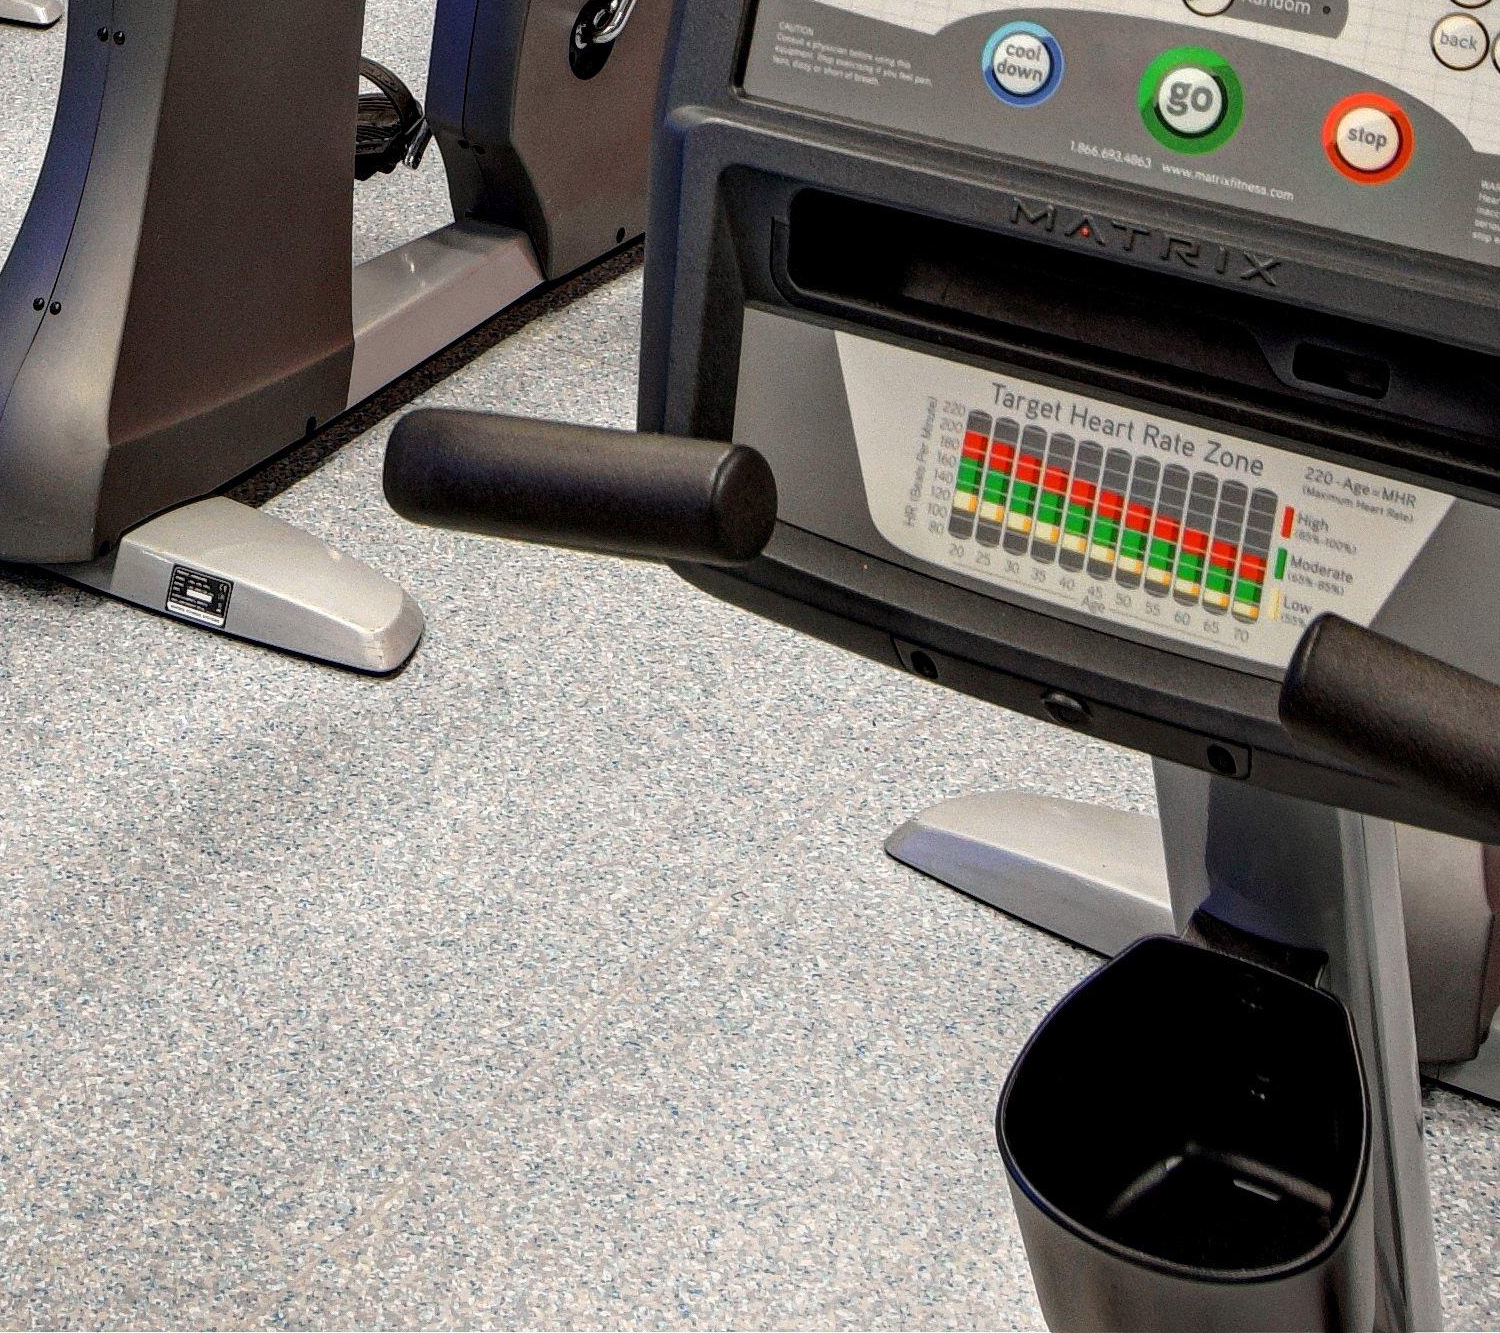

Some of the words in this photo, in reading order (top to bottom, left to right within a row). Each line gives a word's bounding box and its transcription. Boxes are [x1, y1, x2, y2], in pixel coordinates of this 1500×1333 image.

[1005, 43, 1041, 61] cool
[1440, 30, 1478, 52] back
[997, 59, 1043, 83] down
[1166, 81, 1213, 117] go
[1347, 125, 1388, 151] stop
[1161, 162, 1295, 202] www.matrixfitness.com
[1009, 195, 1282, 288] MATRIX
[992, 383, 1062, 422] Target
[1070, 403, 1135, 442] Heart
[1142, 424, 1196, 457] Rate
[1203, 439, 1265, 477] Zone
[1298, 511, 1329, 532] High
[1290, 554, 1354, 583] Moderate
[950, 544, 964, 558] 20
[976, 551, 991, 565] 25
[1005, 558, 1020, 573] 30
[1031, 567, 1046, 582] 35
[1059, 576, 1075, 591] 40
[1088, 585, 1103, 600] 45
[1116, 593, 1132, 608] 50
[1145, 602, 1160, 617] 55
[1174, 611, 1191, 625] 60
[1203, 618, 1220, 633] 65
[1233, 628, 1249, 642] 70
[1283, 596, 1312, 614] Low
